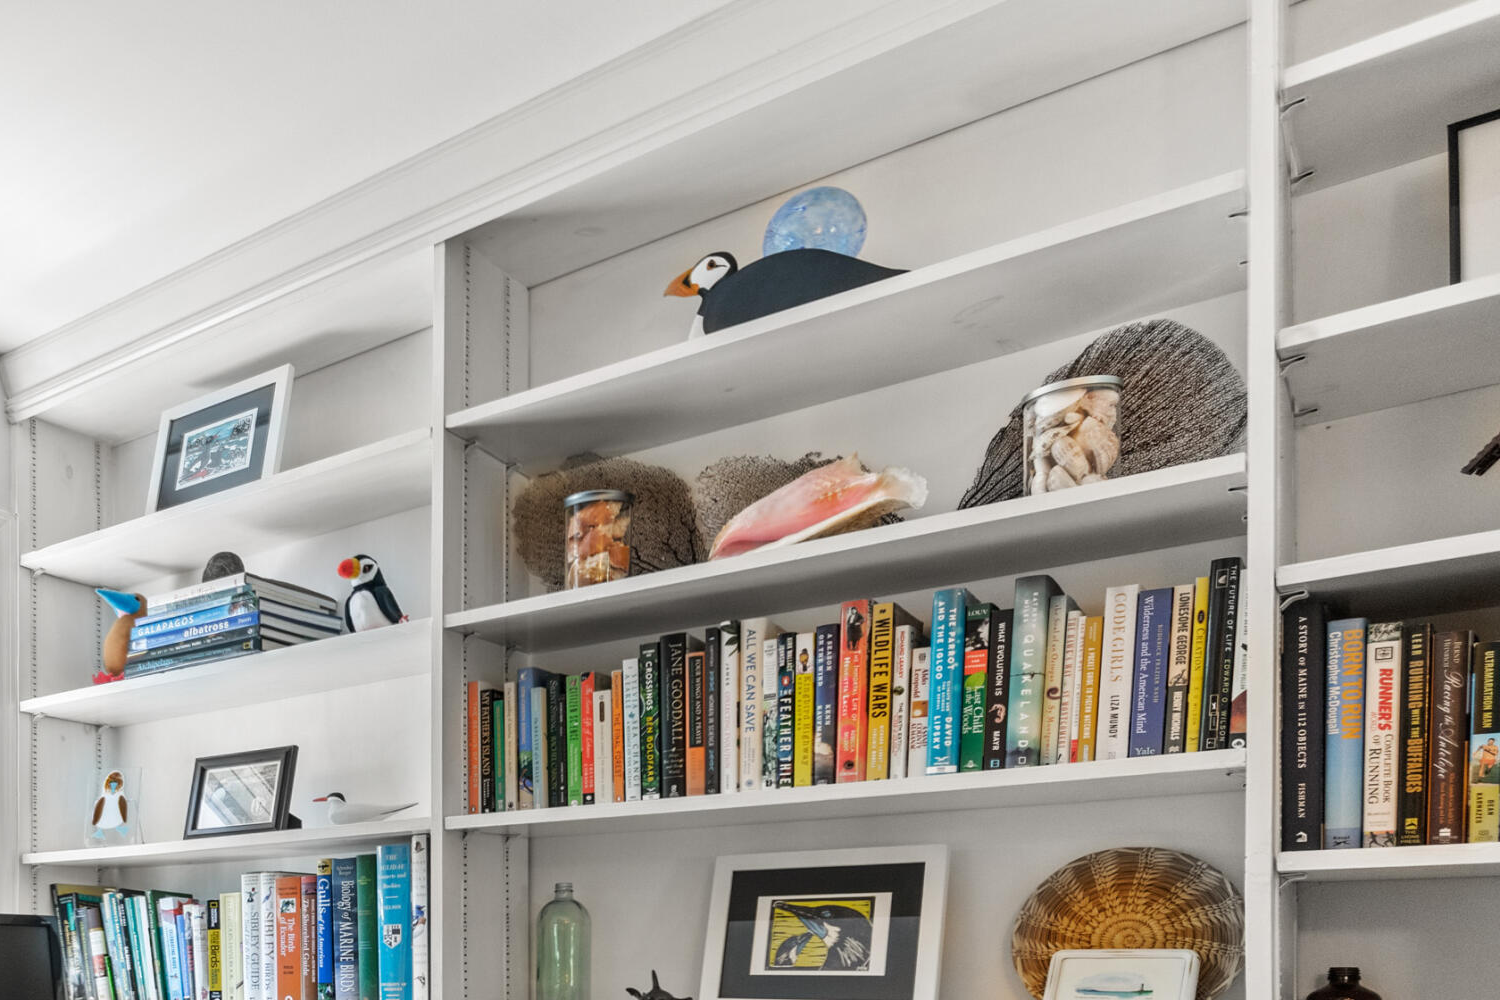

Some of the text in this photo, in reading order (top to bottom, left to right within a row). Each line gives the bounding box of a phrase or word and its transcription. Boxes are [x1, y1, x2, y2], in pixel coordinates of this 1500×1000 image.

[183, 622, 228, 638] albatross
[1175, 592, 1190, 665] LONESOME GEORGE
[1224, 566, 1238, 651] THE FUTURE OF LIFE
[935, 648, 943, 679] IGLOO
[947, 608, 956, 670] THE PARROT
[995, 622, 1006, 696] WHAT EVOLUTION IS
[1110, 593, 1126, 682] CODE GIRLS
[1298, 625, 1308, 654] STORY
[1299, 657, 1306, 666] OF
[645, 661, 653, 710] CROSSINGS
[744, 630, 756, 732] ALL WE CAN SAVE
[872, 618, 890, 718] WILDLIFE WARS
[1018, 634, 1034, 748] QUAKELAND
[1136, 596, 1154, 734] Wilderness and the American Mind
[1298, 668, 1307, 699] MAINE
[1326, 632, 1341, 735] Christopher McDougall
[1341, 629, 1364, 739] BORN TO RUN
[1436, 669, 1464, 713] Racing
[1482, 650, 1494, 728] ULTRAMARATHON MAN
[669, 642, 683, 744] JANE GOODALL
[972, 686, 984, 734] Last Child
[1108, 695, 1120, 738] LIZA MUNDY
[1298, 712, 1306, 726] 112
[1377, 668, 1393, 731] RUNNER'S
[1406, 634, 1424, 794] LEAR RUNNING WITH THE BUFFALOES
[932, 716, 941, 750] LIPSKY
[944, 717, 952, 746] DAVID
[962, 705, 972, 734] Woods
[992, 731, 1000, 750] MAYR
[1296, 730, 1306, 768] OBJECTS
[1382, 734, 1394, 804] COMPLETE BOOK
[1432, 724, 1458, 779] Antelope
[1298, 782, 1306, 818] FISHMAN
[1367, 748, 1381, 804] RUNNING
[318, 878, 330, 912] Gulls
[210, 944, 219, 968] Birds
[250, 912, 260, 990] SIBLEY GUIDE
[280, 926, 288, 956] Ecuador
[287, 917, 296, 953] The Birds
[338, 880, 355, 992] Biology of MARINE BIRDS
